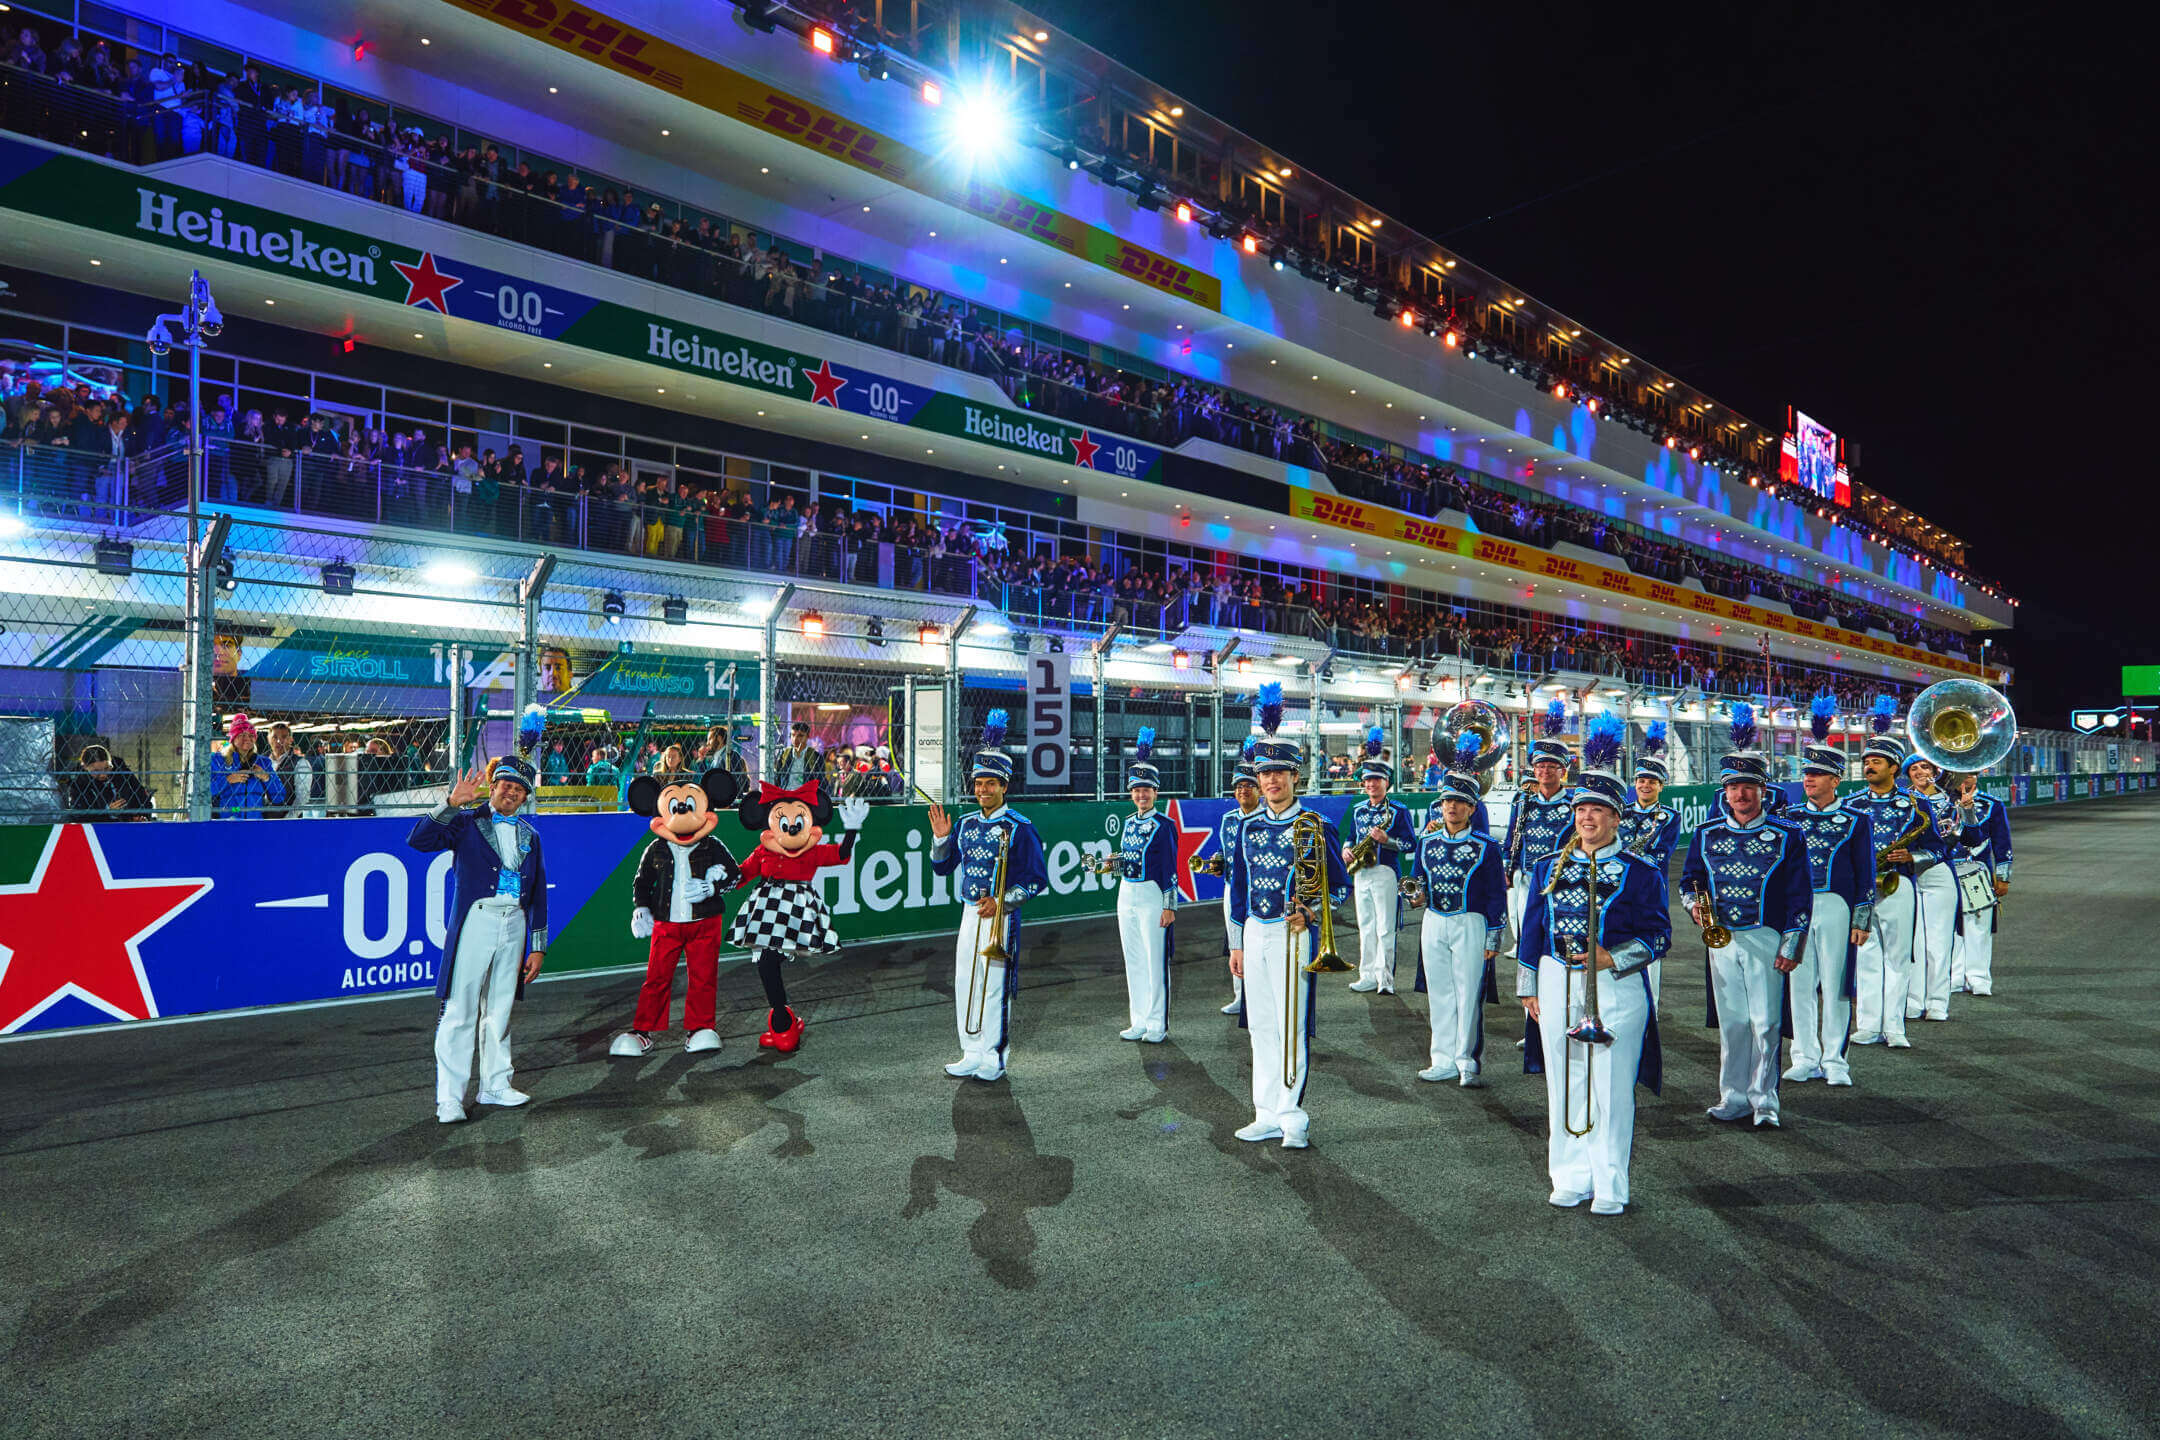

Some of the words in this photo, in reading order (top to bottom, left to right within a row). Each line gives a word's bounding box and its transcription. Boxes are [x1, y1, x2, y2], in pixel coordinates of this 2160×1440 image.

[489, 0, 656, 77] DHL
[761, 93, 886, 170] DHL
[966, 177, 1059, 242] DHL
[1119, 245, 1195, 298] DHL
[498, 285, 543, 326] 0.0
[869, 382, 900, 414] 0.0
[1115, 446, 1137, 473] 0.0
[1312, 496, 1367, 530] DHL
[1404, 519, 1450, 549] DHL
[1480, 539, 1520, 566] DHL
[1545, 556, 1580, 580] DHL
[311, 655, 409, 680] STROLL
[608, 671, 695, 694] ALONSO
[704, 660, 740, 697] 14
[1031, 659, 1065, 778] 150
[2109, 749, 2118, 766] 50
[341, 960, 434, 989] ALCOHOL
